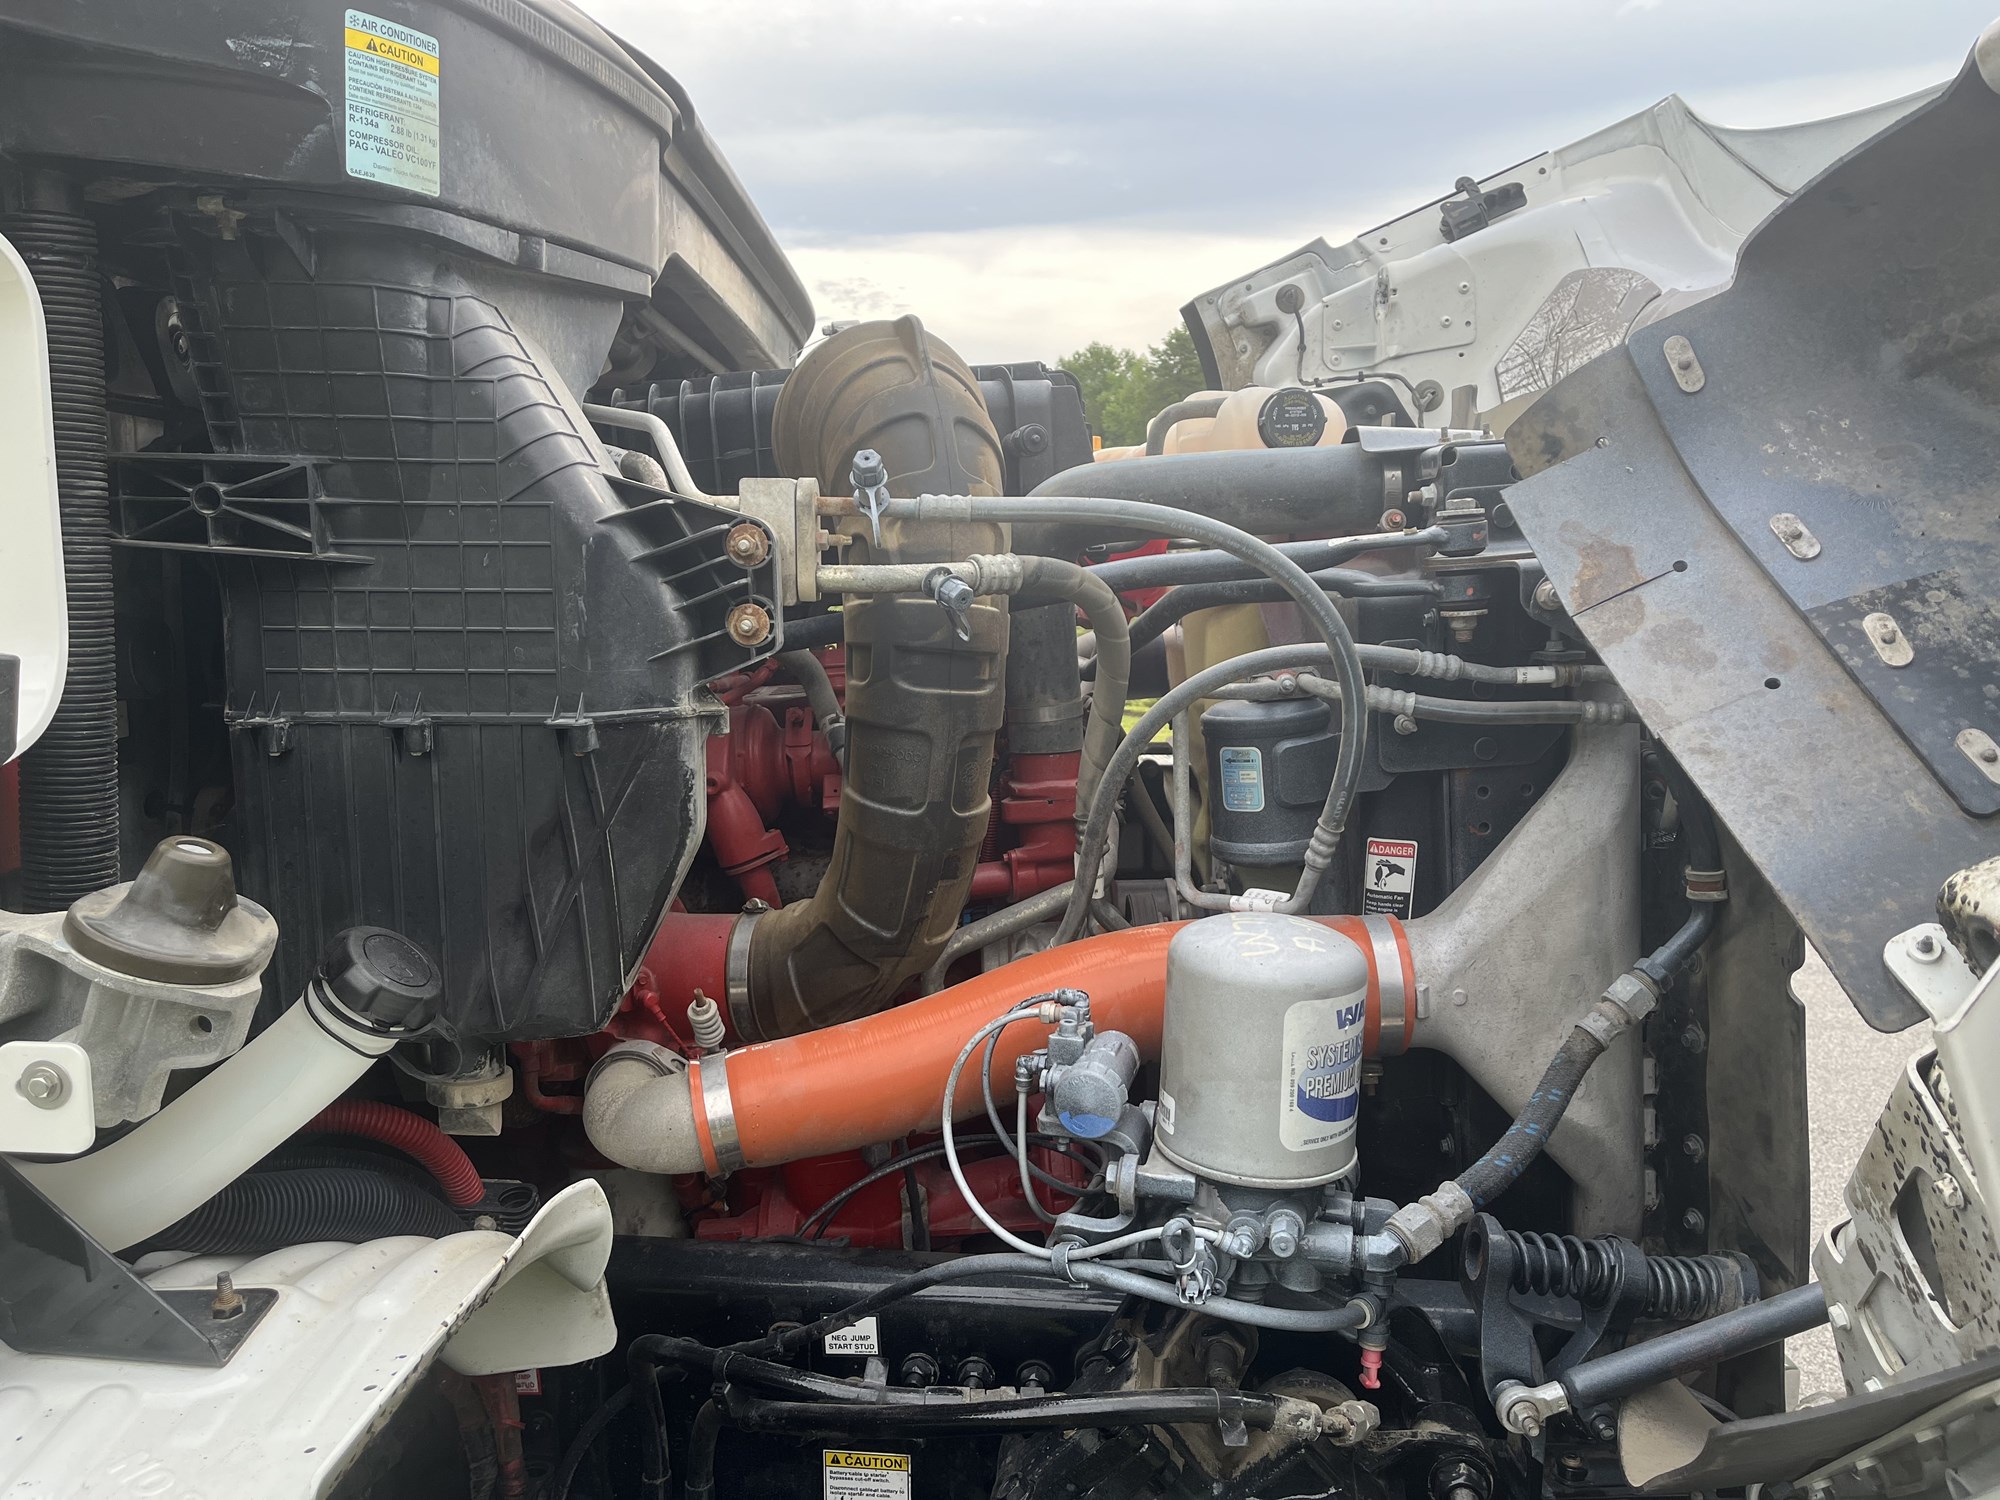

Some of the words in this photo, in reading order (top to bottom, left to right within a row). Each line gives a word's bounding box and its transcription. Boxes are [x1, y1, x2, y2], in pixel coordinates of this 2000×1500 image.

[361, 19, 378, 32] AIR
[381, 24, 437, 54] CONDITIONER
[348, 50, 374, 64] CAUTION
[376, 58, 389, 67] HIGH
[390, 62, 417, 77] PRESSURE
[419, 72, 436, 84] SYSTEM
[380, 43, 424, 66] CAUTION
[348, 56, 378, 72] CONTAINS
[379, 66, 415, 83] REFRIGERANT
[348, 82, 374, 97] CONTIENE
[376, 90, 411, 107] REFRIGERANTE
[383, 86, 403, 97] SISTEMA
[349, 112, 378, 129] R-134a
[390, 124, 404, 136] 2.88
[405, 129, 411, 138] lb
[413, 131, 427, 144] (1.31
[428, 136, 437, 148] kg)
[349, 128, 404, 151] COMPRESSOR
[349, 138, 368, 151] PAG
[375, 144, 403, 160] VALEO
[405, 153, 436, 170] VC100YF
[1379, 846, 1414, 856] DANGER
[1367, 892, 1393, 900] Automatic
[1307, 1036, 1357, 1070] SYSTEM
[1306, 1064, 1356, 1099] PREMIUM
[844, 1456, 902, 1468] CAUTION
